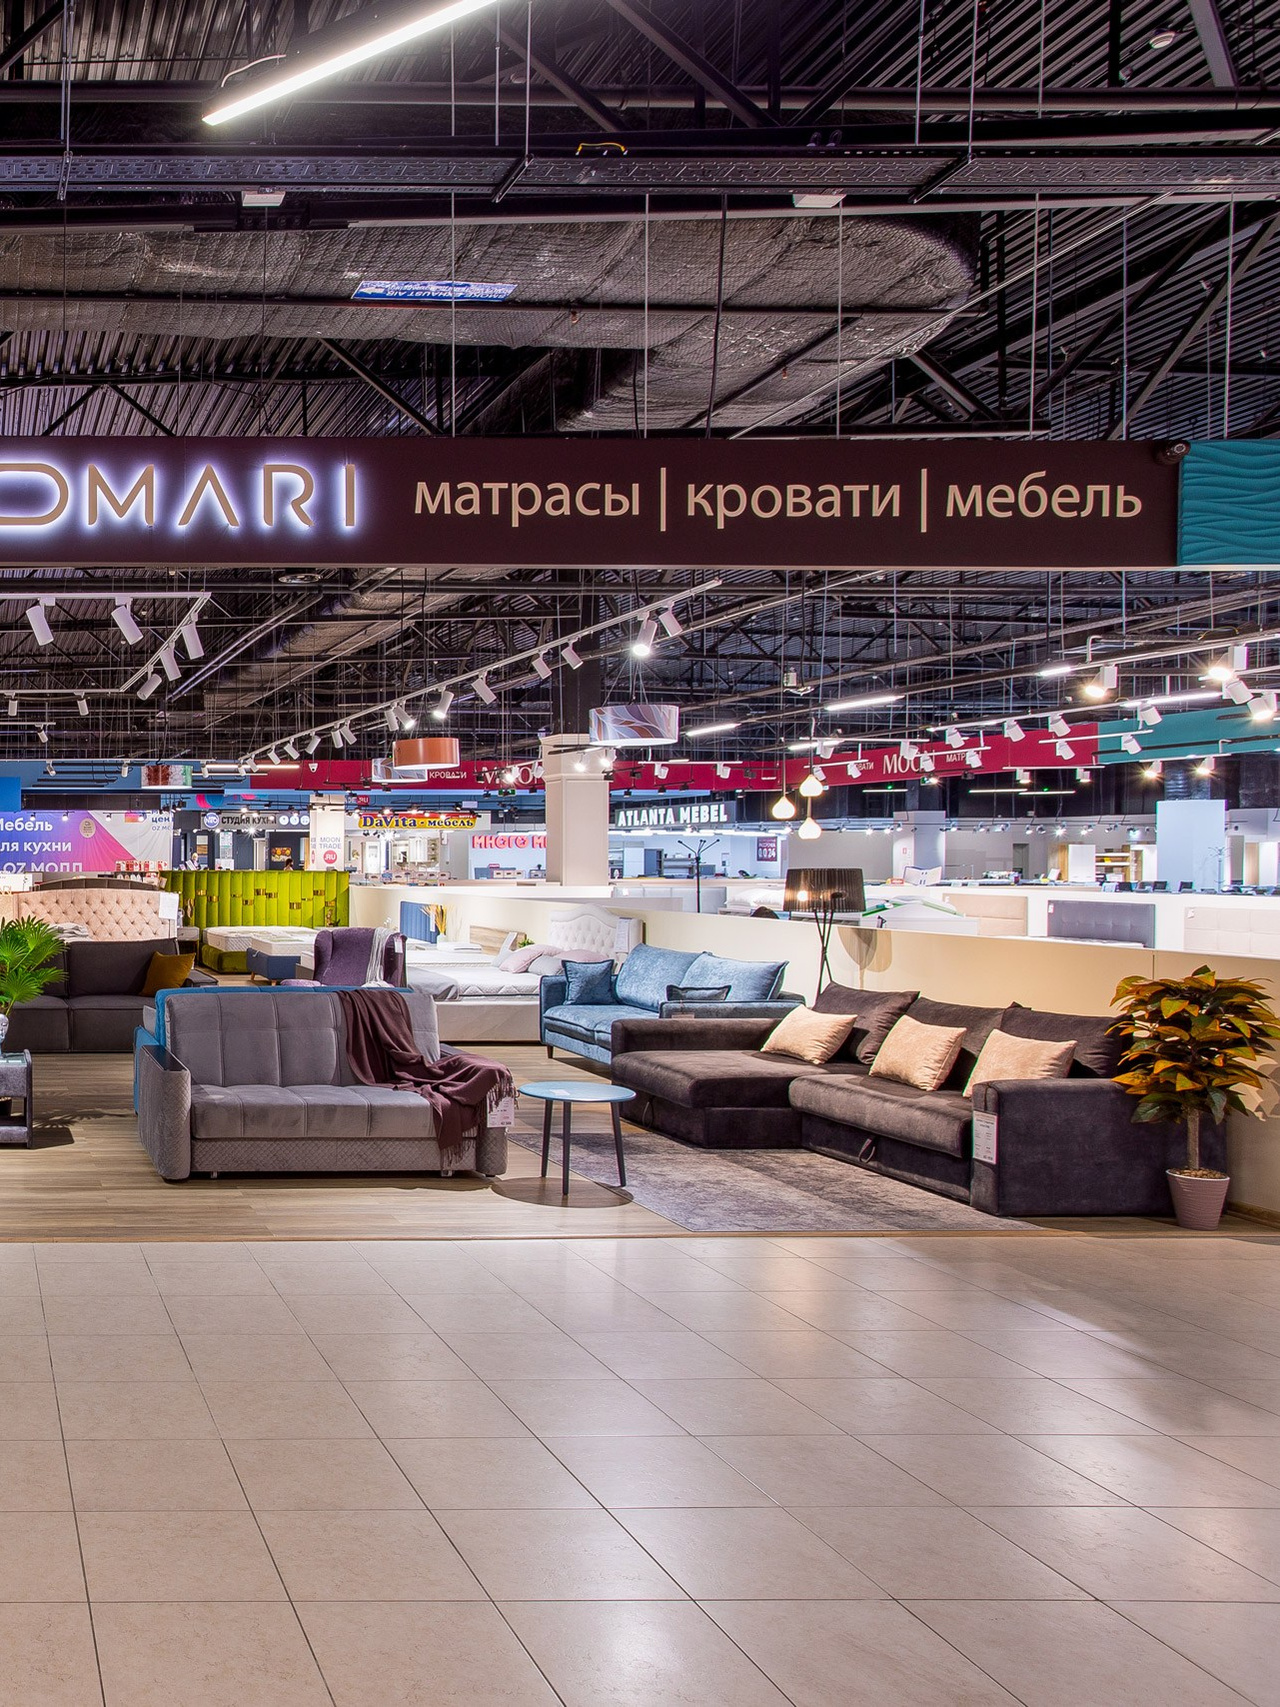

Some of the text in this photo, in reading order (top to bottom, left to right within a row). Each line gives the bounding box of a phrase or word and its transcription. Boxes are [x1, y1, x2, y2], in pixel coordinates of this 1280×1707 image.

[413, 470, 1143, 530] матрасы кровати мебель
[362, 815, 417, 827] DaVita
[427, 817, 474, 827] мебель
[618, 804, 728, 827] ATLANTA MEBEL
[23, 842, 72, 855] кухни
[472, 834, 529, 849] МНОГО
